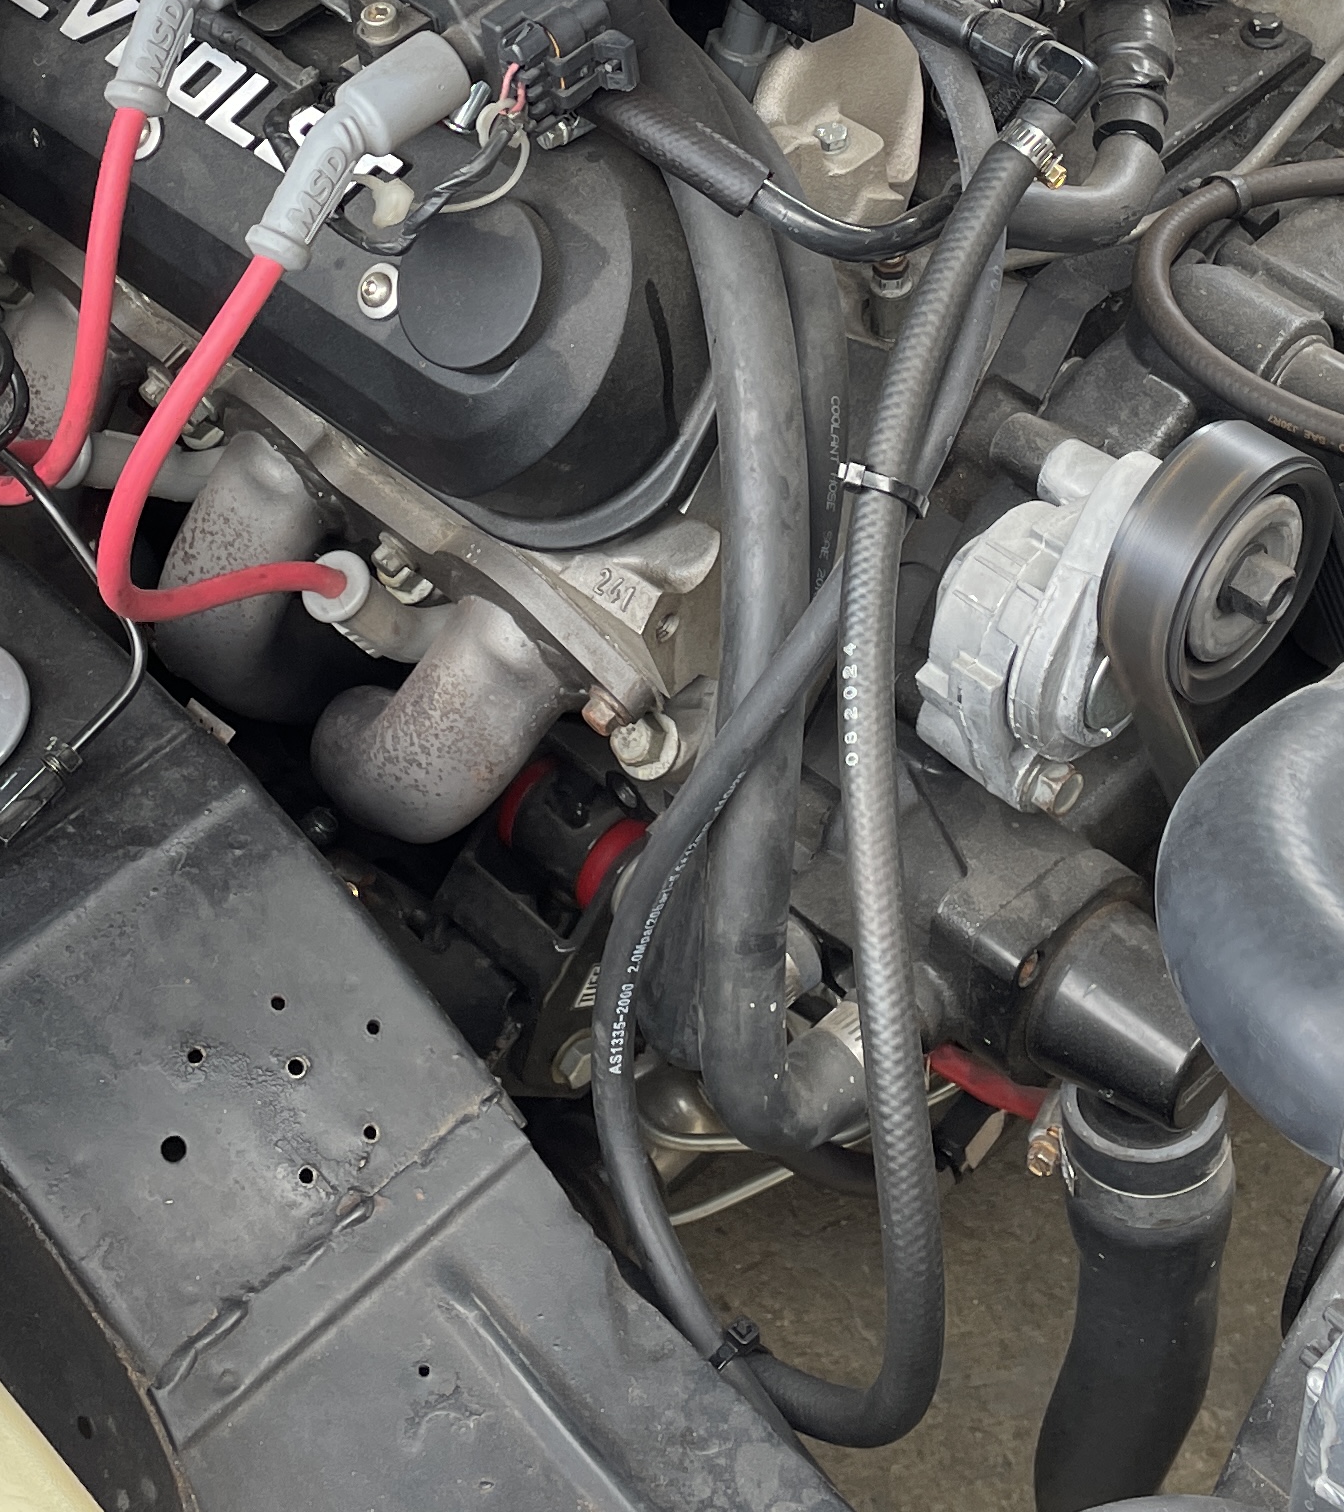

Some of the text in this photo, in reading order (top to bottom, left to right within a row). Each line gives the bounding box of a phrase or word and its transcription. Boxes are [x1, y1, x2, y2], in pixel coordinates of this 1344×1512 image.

[287, 145, 348, 237] MSD
[830, 395, 841, 466] COOLANT
[1267, 414, 1299, 433] J30R7
[1303, 429, 1329, 445] SAE
[818, 530, 832, 560] SAE
[593, 567, 636, 612] 241
[608, 983, 634, 1076] AS1335-2000
